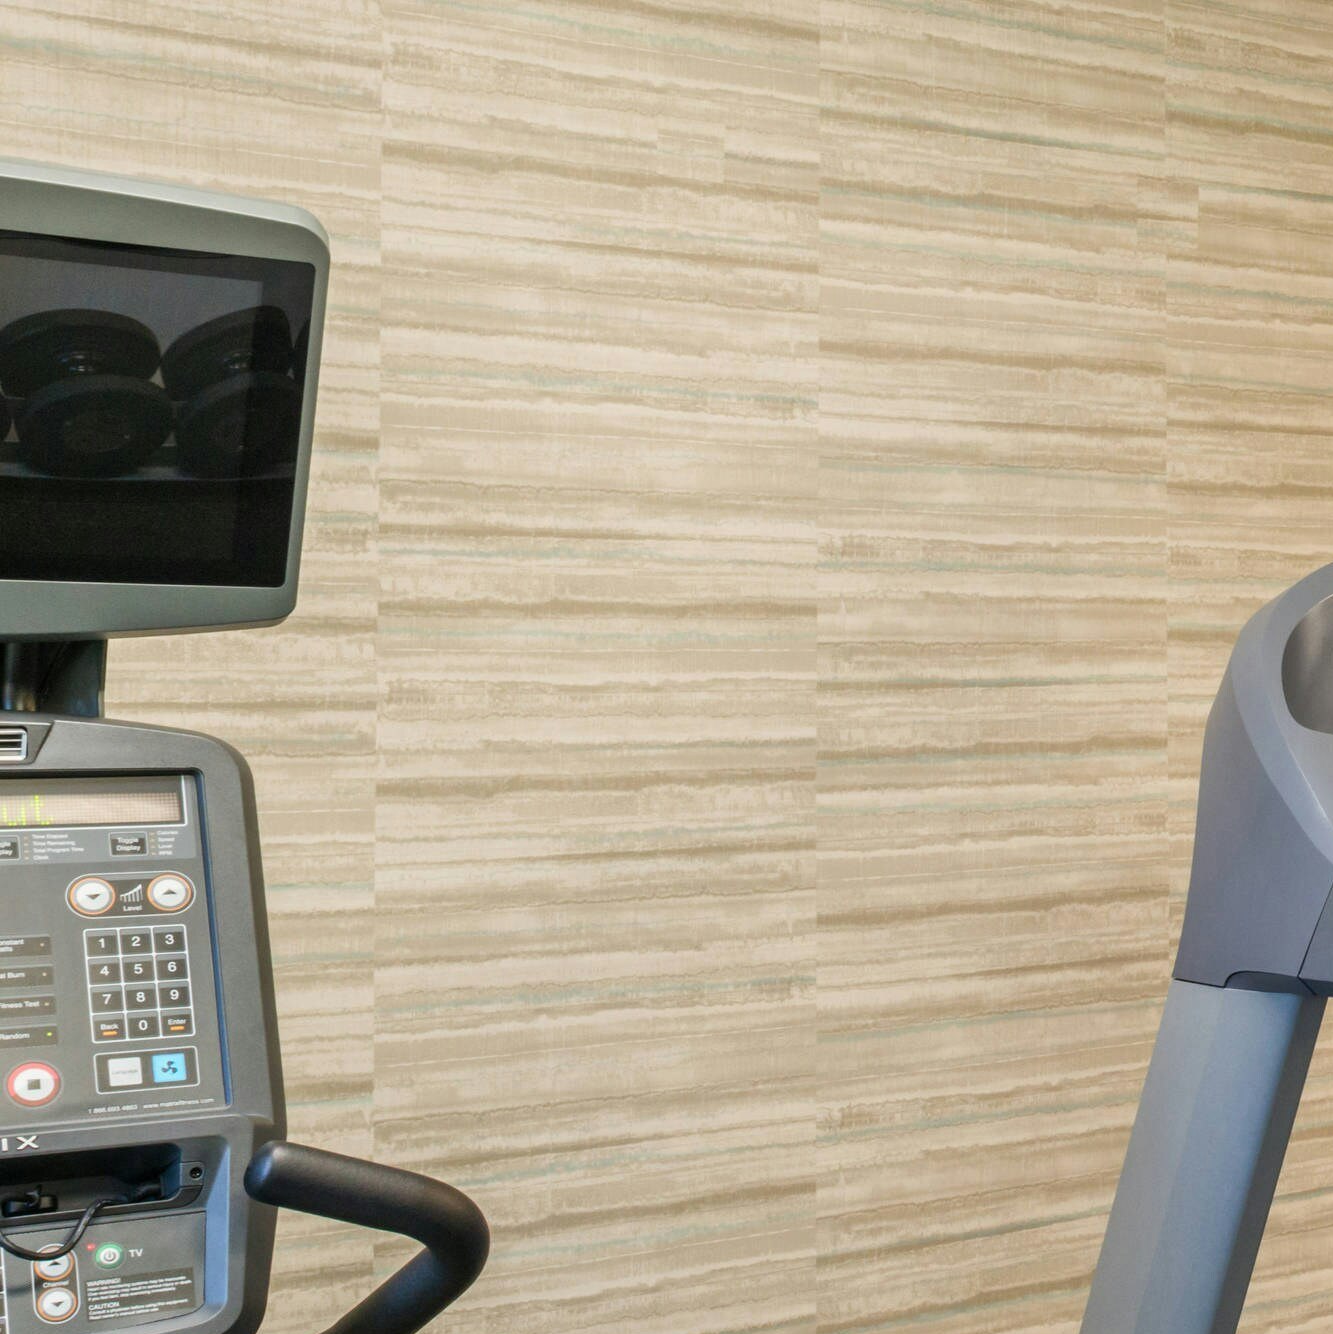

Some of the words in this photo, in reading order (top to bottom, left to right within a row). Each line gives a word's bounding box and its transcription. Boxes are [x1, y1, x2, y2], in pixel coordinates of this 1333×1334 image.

[123, 904, 143, 912] Level
[98, 938, 105, 948] 1
[131, 936, 141, 947] 2
[165, 934, 175, 945] 3
[100, 965, 110, 976] 4
[134, 963, 143, 974] 5
[167, 962, 177, 972] 6
[102, 994, 112, 1004] 7
[136, 991, 146, 1002] 8
[170, 989, 179, 1000] 9
[138, 1019, 148, 1031] 0
[129, 1249, 143, 1257] TV
